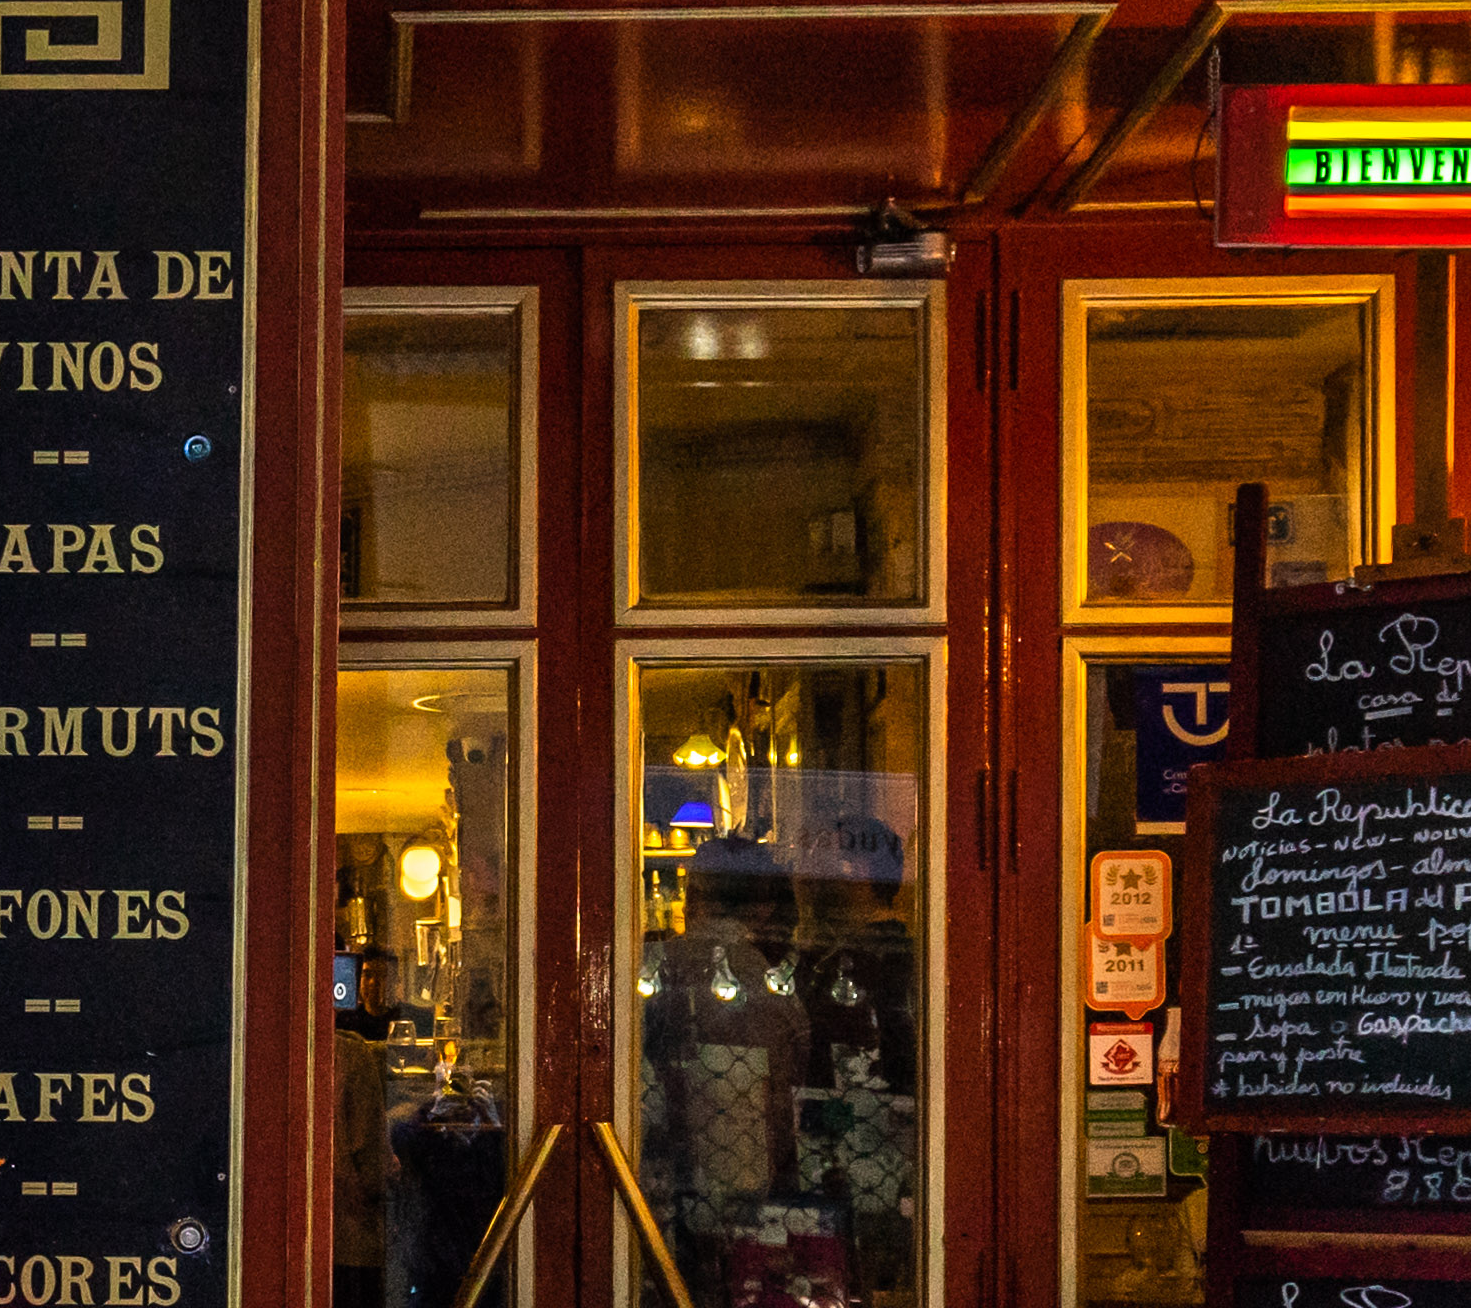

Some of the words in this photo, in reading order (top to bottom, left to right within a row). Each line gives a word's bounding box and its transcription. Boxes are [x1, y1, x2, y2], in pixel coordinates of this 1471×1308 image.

[153, 250, 235, 301] DE
[1307, 629, 1376, 683] La
[1357, 691, 1424, 711] casa
[1436, 678, 1461, 702] de
[1251, 791, 1303, 829] La
[1110, 892, 1151, 906] 2012
[1230, 887, 1408, 925] TOMBOLA
[1414, 886, 1445, 909] del
[1105, 959, 1145, 973] 2011
[1247, 949, 1357, 980] Ensalada
[1294, 1035, 1367, 1073] postre
[1324, 1078, 1356, 1095] no
